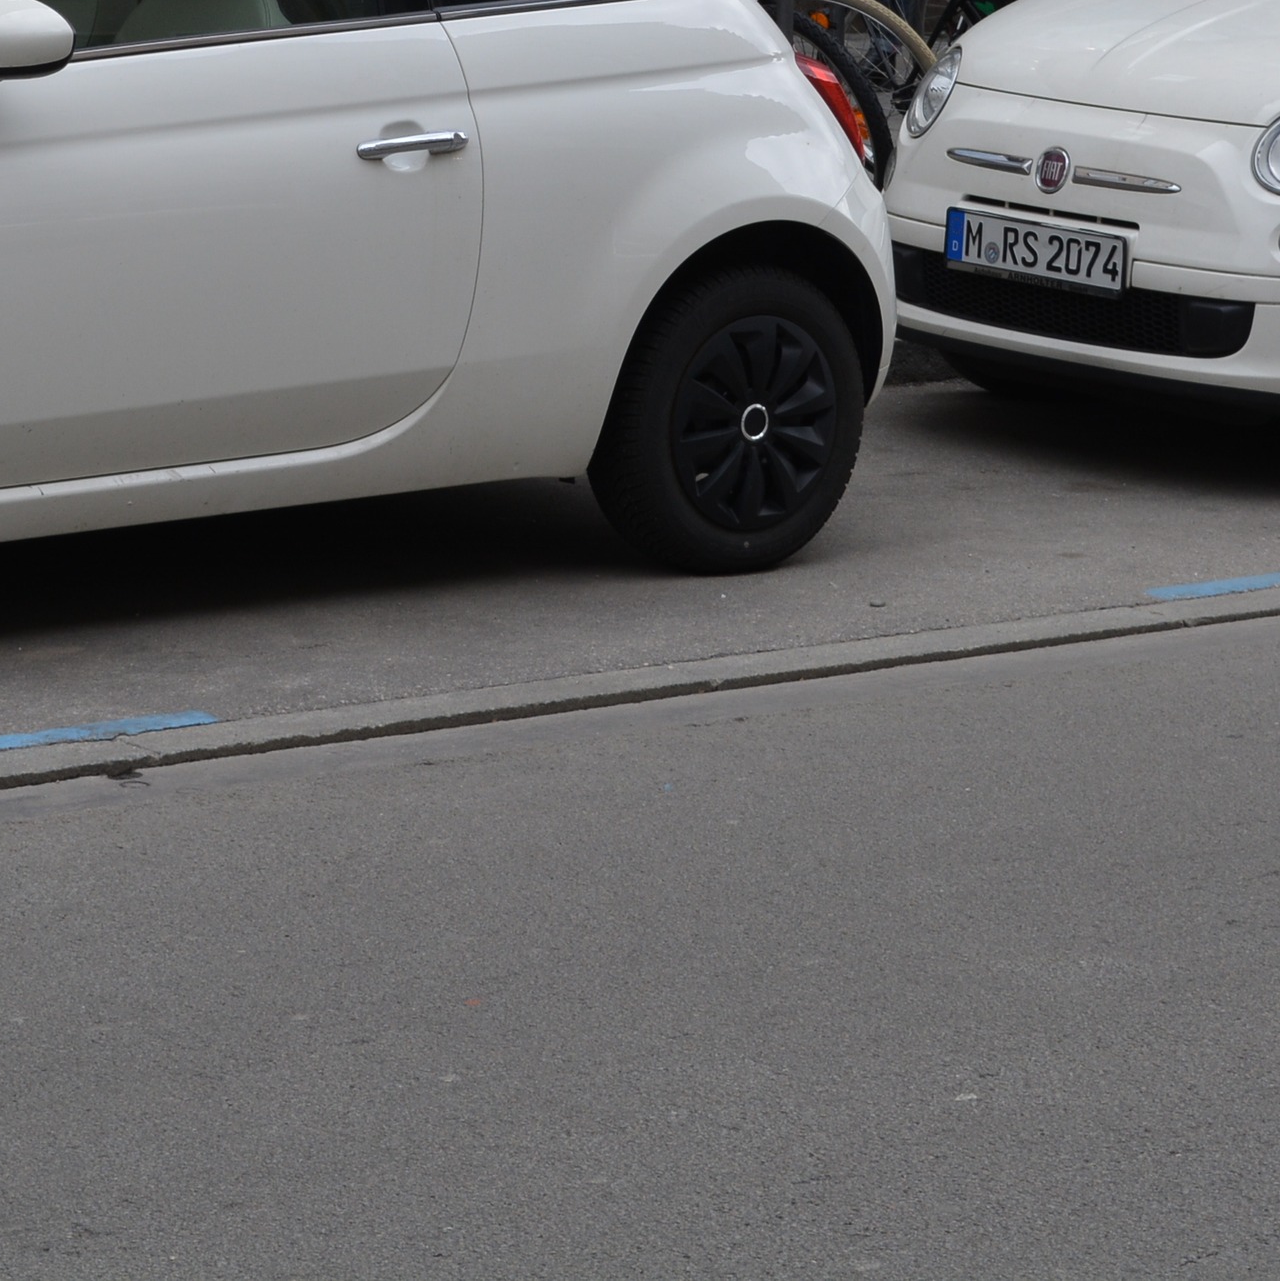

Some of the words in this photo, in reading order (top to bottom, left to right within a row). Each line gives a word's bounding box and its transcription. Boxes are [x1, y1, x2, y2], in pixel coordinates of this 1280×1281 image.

[1040, 160, 1064, 183] FIAT
[951, 239, 959, 252] D
[964, 219, 984, 259] M
[1001, 226, 1039, 268] RS
[1046, 234, 1119, 283] 2074
[1007, 272, 1064, 290] ARNHOLTER
